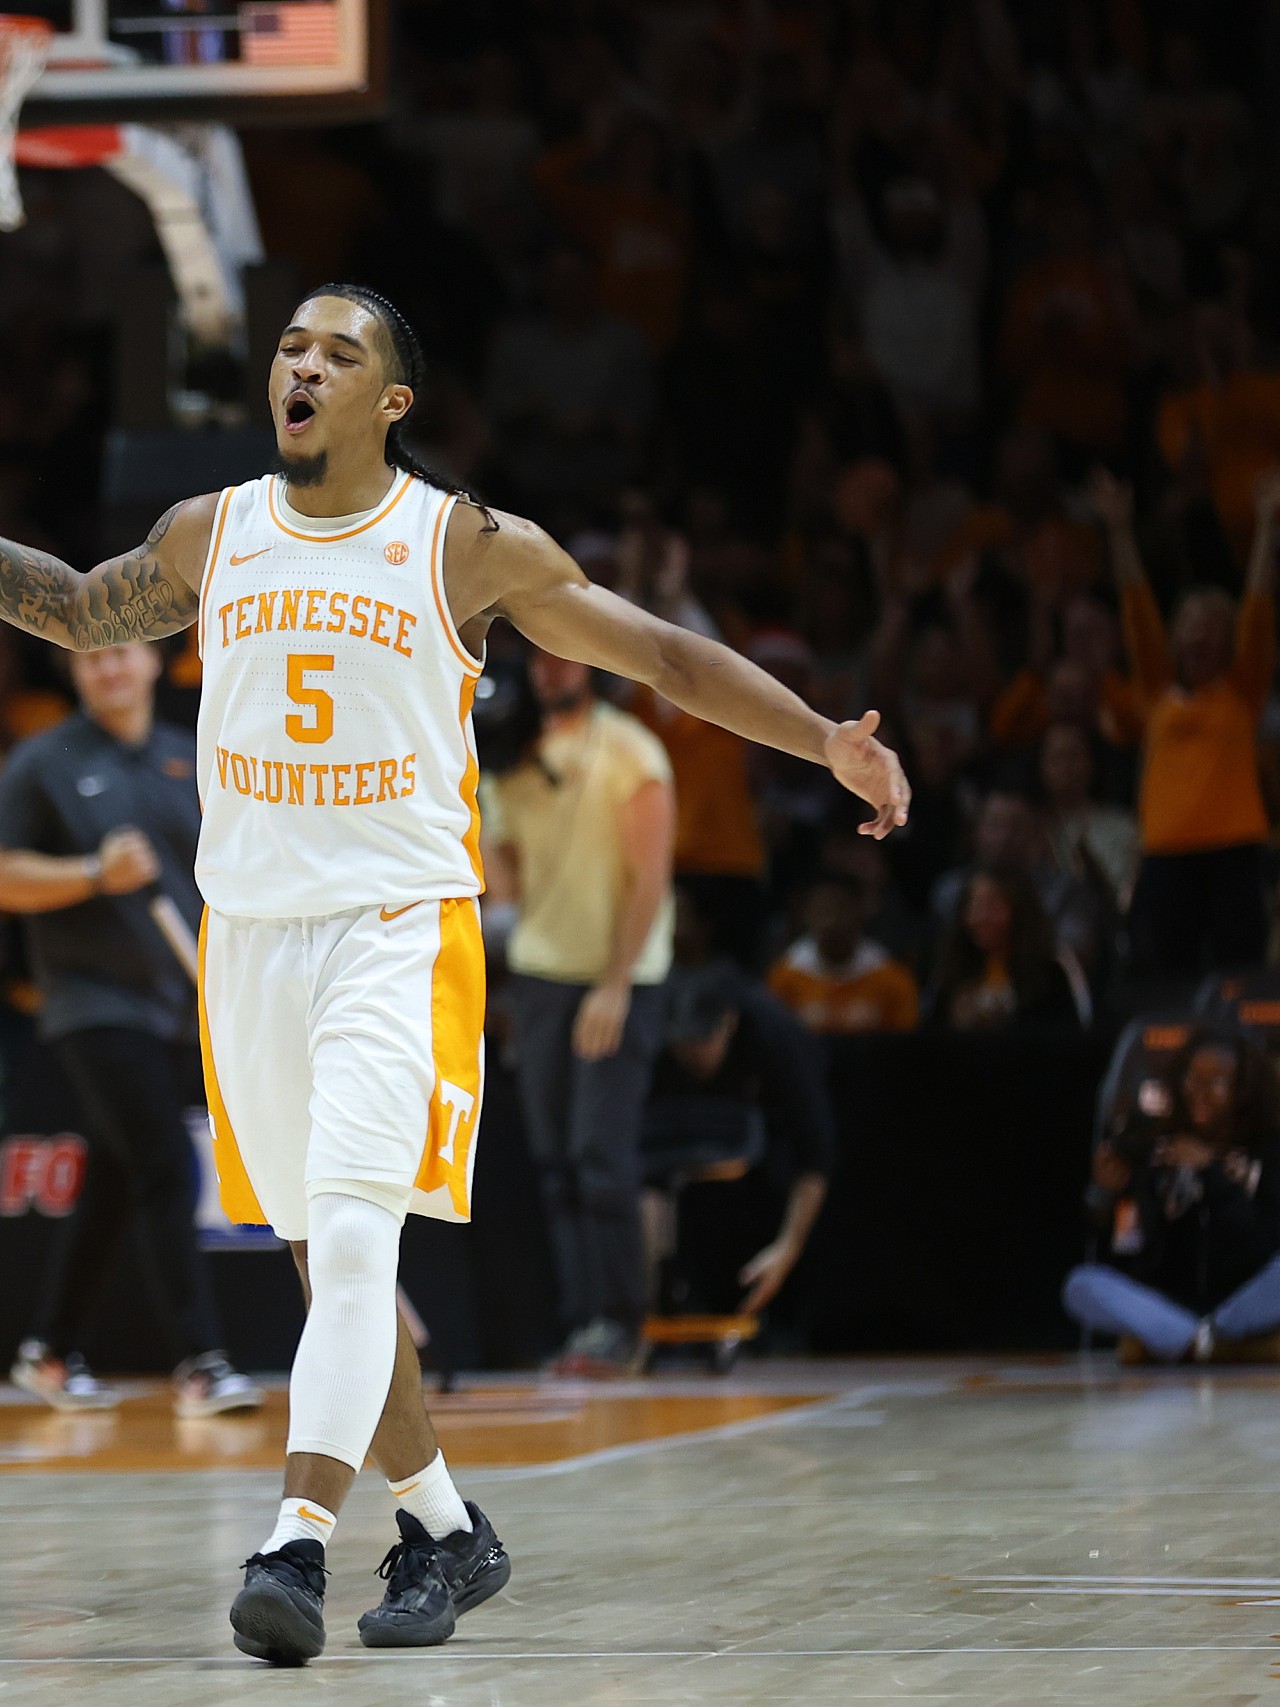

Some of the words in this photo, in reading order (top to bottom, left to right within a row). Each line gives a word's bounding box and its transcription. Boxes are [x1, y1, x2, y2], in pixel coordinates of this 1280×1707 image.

[386, 543, 408, 563] SEC
[76, 579, 174, 651] GODSPEED
[218, 590, 417, 659] TENNESSEE
[285, 654, 335, 744] 5
[216, 746, 416, 806] VOLUNTEERS
[438, 1079, 475, 1166] T
